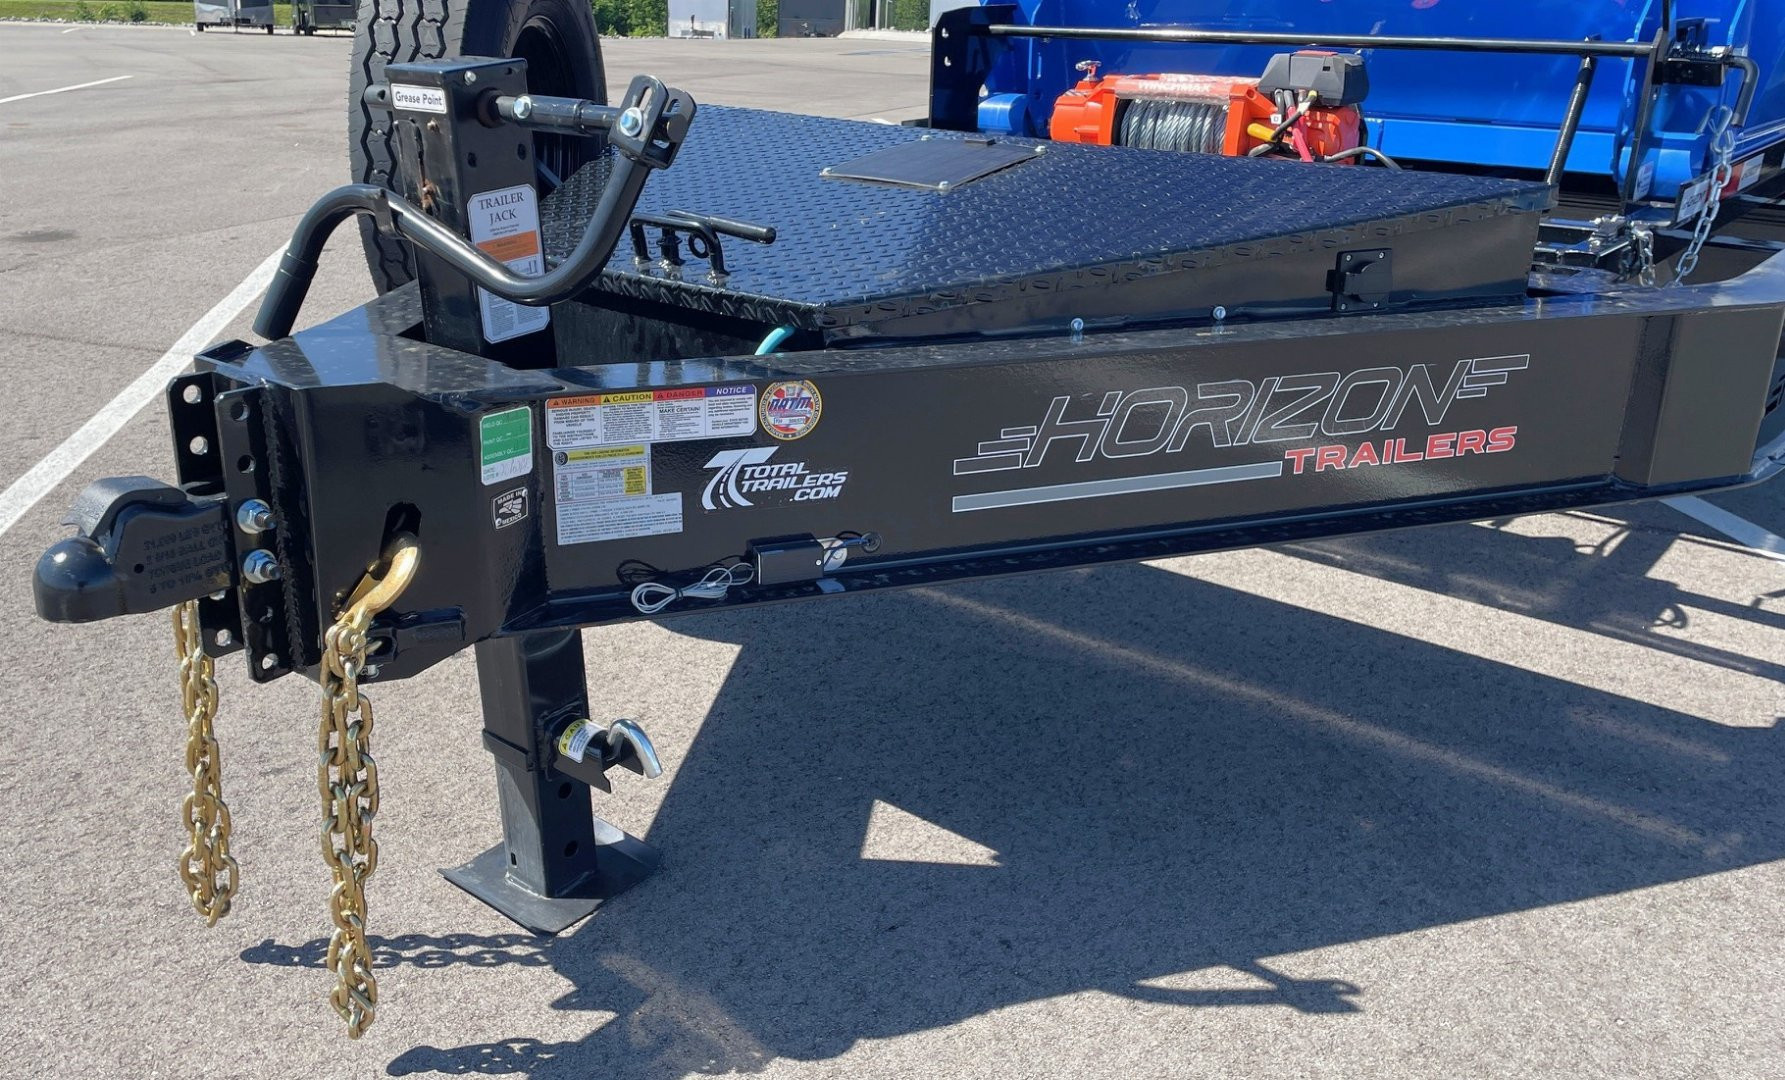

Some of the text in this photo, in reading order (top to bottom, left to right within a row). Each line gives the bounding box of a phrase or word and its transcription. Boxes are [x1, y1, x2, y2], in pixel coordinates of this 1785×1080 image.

[395, 91, 443, 106] Grease Point
[477, 191, 525, 211] TRAILER
[489, 208, 517, 225] JACK
[612, 393, 652, 402] CAUTION
[666, 389, 703, 399] DANGER
[716, 386, 747, 395] NOTICE
[561, 397, 595, 406] WARNING
[1023, 358, 1474, 468] HORIZON
[1284, 425, 1519, 476] TRAILERS
[743, 462, 810, 480] TOTAL
[741, 471, 849, 493] TRAILERS
[497, 492, 515, 505] MADE
[789, 485, 843, 502] .COM
[502, 512, 522, 525] MEXICO
